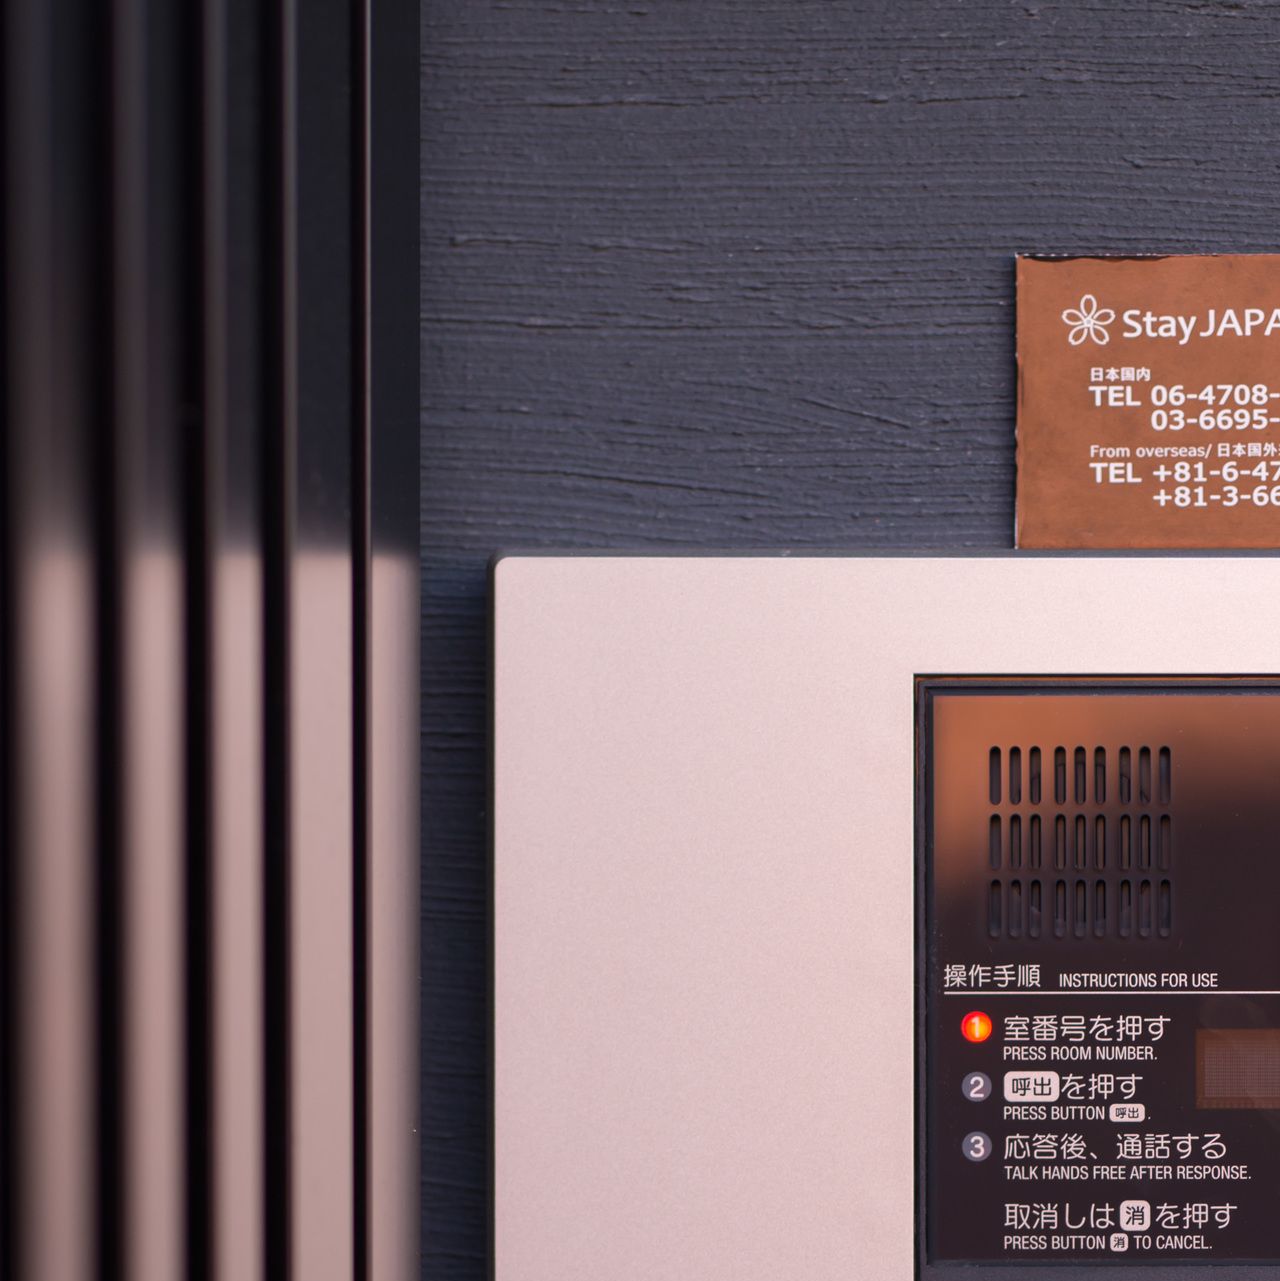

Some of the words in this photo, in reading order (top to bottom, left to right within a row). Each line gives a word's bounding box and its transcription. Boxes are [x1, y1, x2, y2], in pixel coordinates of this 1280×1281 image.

[1122, 309, 1197, 345] Stay
[1090, 366, 1151, 382] 日本国内
[1088, 385, 1142, 407] TEL
[1090, 444, 1131, 459] From
[1135, 443, 1213, 459] overseas/
[1088, 462, 1143, 484] TEL
[943, 963, 1041, 988] 操作手順
[1059, 972, 1158, 988] INSTRUCTIONS
[1161, 972, 1188, 988] FOR
[1191, 972, 1219, 988] USE
[1003, 1014, 1172, 1042] 室番号を押す
[1003, 1045, 1047, 1061] PRESS
[1050, 1045, 1092, 1061] ROOM
[1096, 1045, 1158, 1061] NUMBER.
[1003, 1105, 1047, 1121] PRESS
[1051, 1105, 1105, 1121] BUTTON
[1003, 1132, 1227, 1160] 応答後、通話する
[1004, 1165, 1039, 1180] TALK
[1042, 1165, 1089, 1180] HANDS
[1092, 1165, 1126, 1180] FREE
[1129, 1165, 1173, 1180] AFTER
[1176, 1165, 1252, 1180] RESPONSE.
[1003, 1235, 1048, 1250] PRESS
[1051, 1235, 1106, 1250] BUTTON
[1133, 1234, 1152, 1250] TO
[1155, 1234, 1213, 1250] CANCEL.
